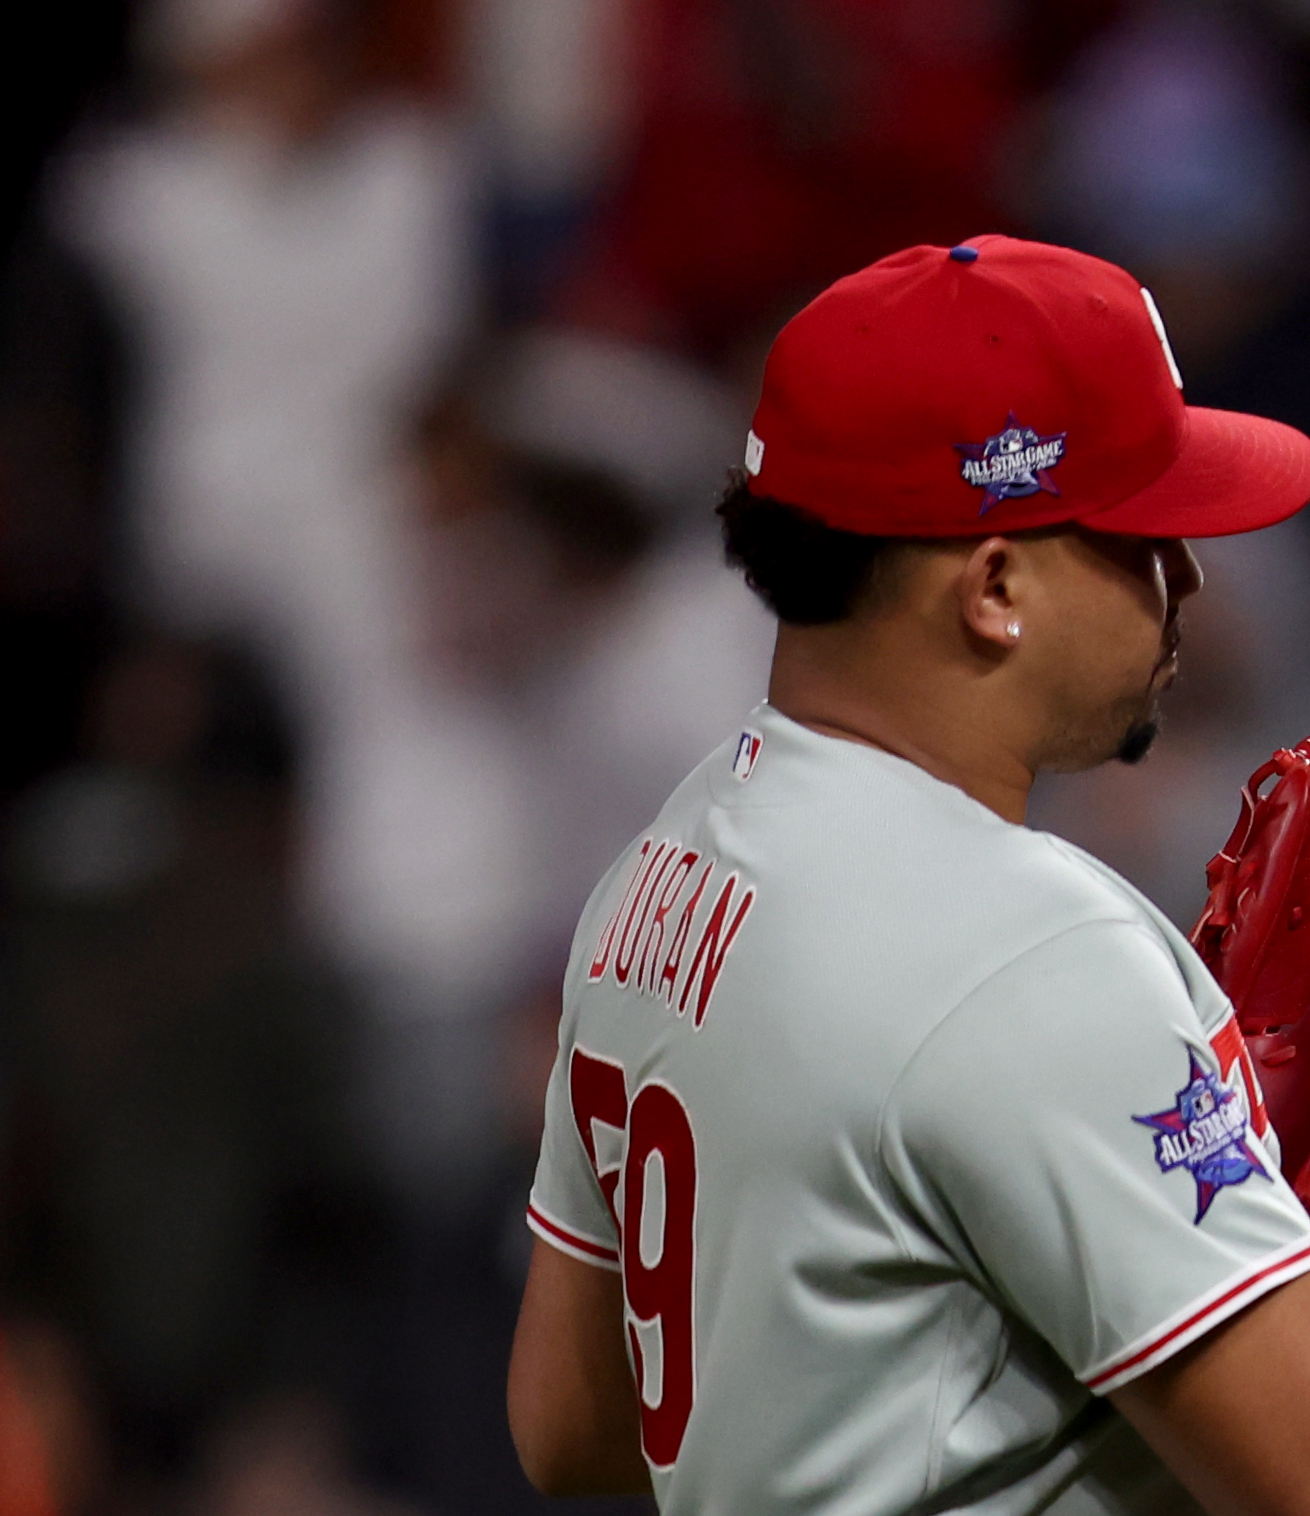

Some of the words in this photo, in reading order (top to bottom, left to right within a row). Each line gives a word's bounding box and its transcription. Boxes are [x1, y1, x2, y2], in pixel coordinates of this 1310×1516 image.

[963, 460, 991, 480] ALL
[991, 453, 1027, 474] STAR
[1026, 440, 1063, 466] GAME
[587, 836, 757, 1033] DURAN
[1160, 1131, 1192, 1165] ALL
